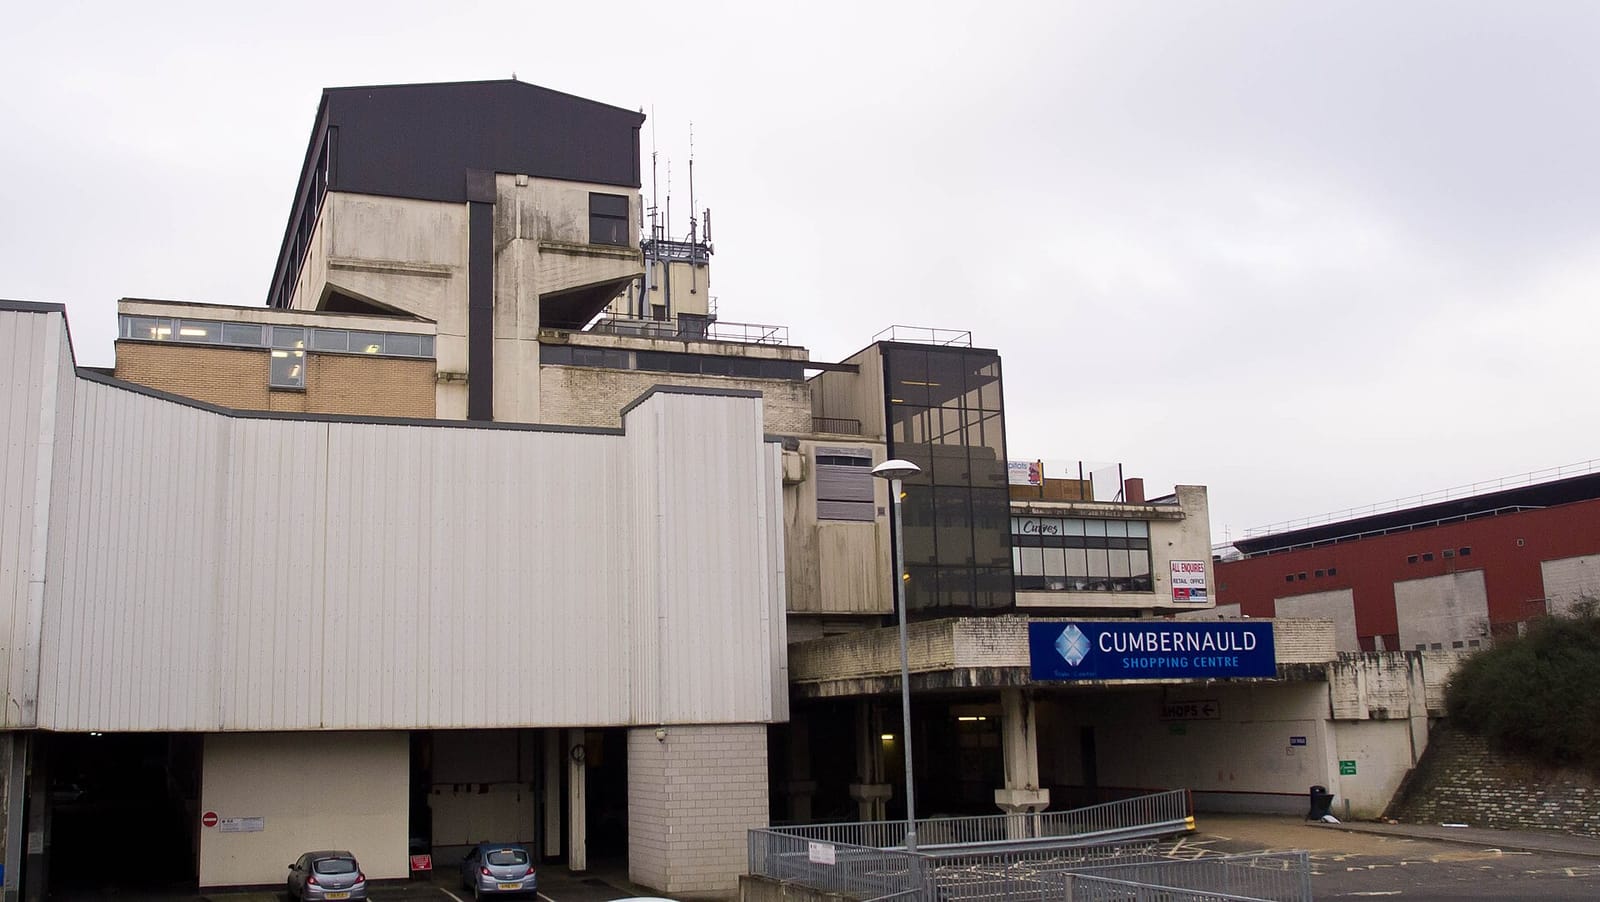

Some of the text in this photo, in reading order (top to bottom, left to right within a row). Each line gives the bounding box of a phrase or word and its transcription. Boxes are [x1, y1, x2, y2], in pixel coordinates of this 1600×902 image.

[1023, 520, 1058, 535] Curves
[1172, 562, 1204, 575] ALL ENQUIRIES
[1099, 631, 1257, 653] CUMBERNAULD
[1122, 656, 1239, 668] SHOPPING CENTRE
